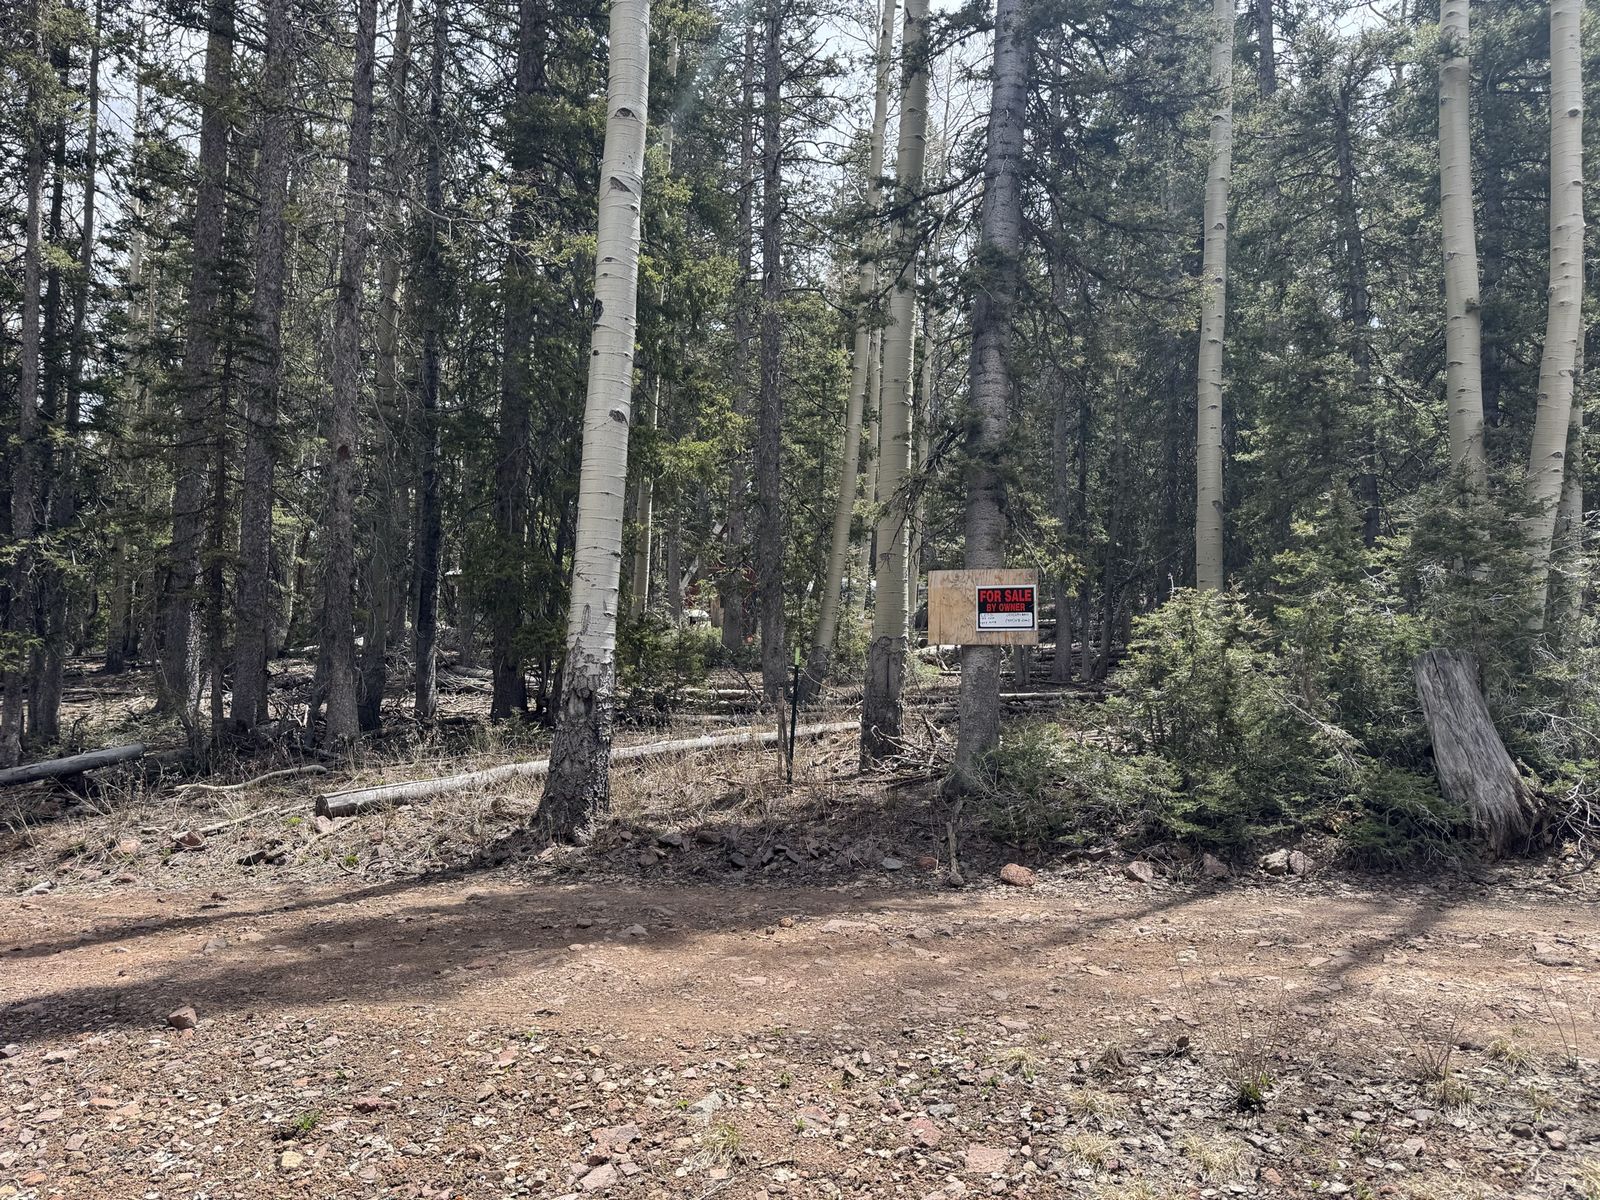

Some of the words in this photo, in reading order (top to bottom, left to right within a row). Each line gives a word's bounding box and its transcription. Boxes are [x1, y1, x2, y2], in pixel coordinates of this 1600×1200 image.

[980, 590, 1001, 602] FOR
[1005, 589, 1032, 602] SALE
[986, 603, 996, 612] BY
[999, 603, 1025, 611] OWNER
